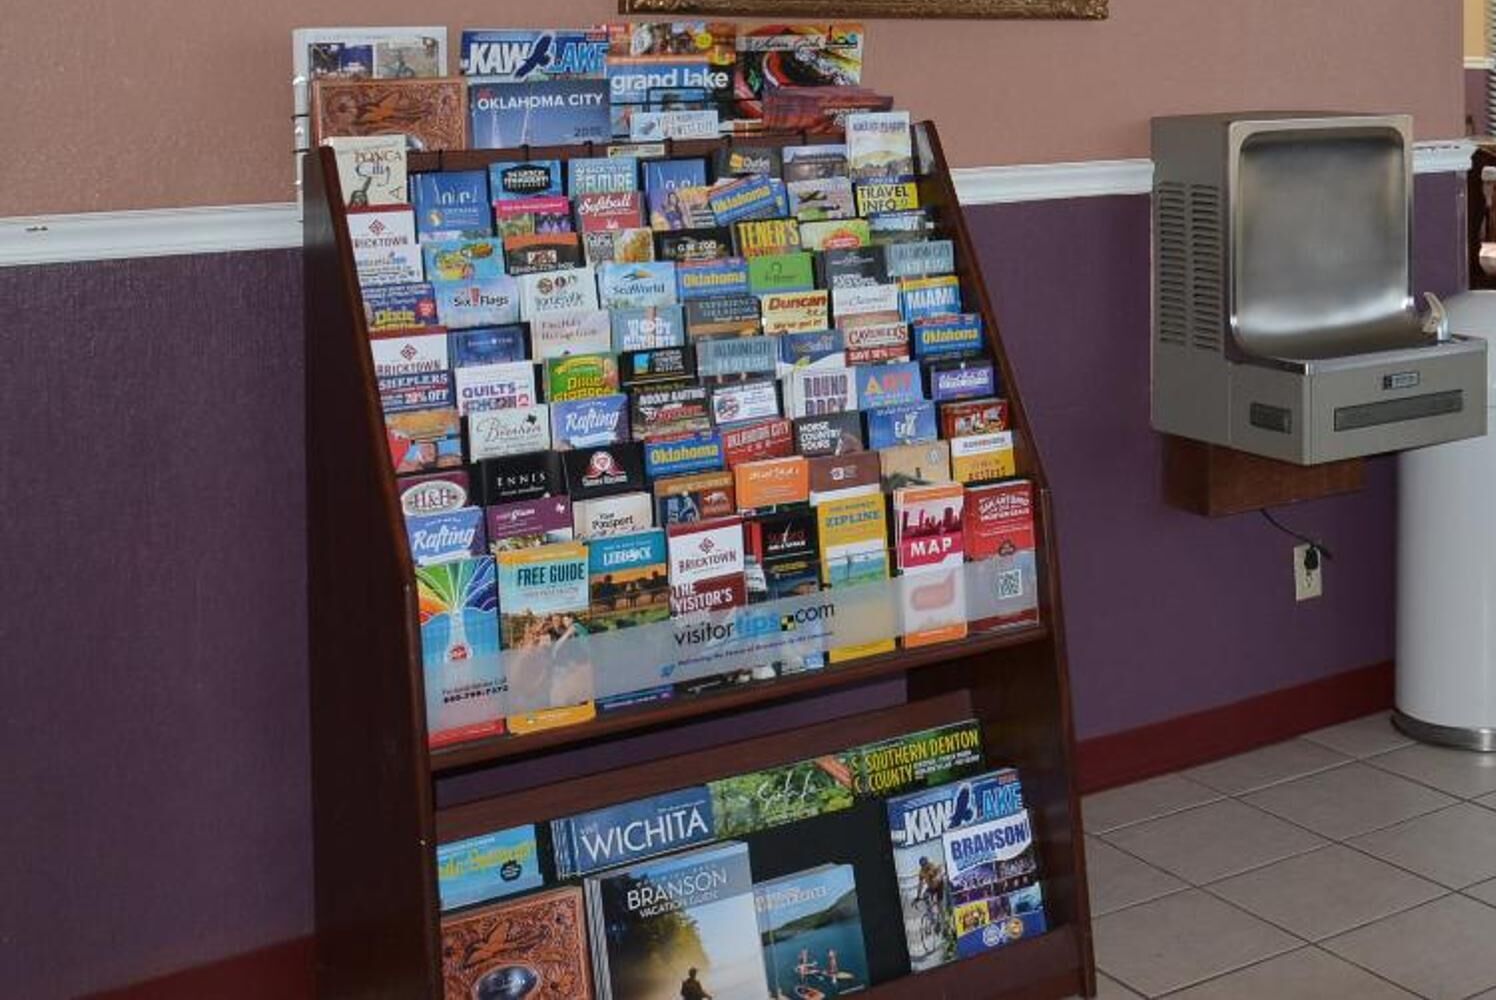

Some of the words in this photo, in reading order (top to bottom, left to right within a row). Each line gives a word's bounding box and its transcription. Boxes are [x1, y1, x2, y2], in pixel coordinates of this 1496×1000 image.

[467, 41, 531, 74] KAW
[547, 42, 609, 72] LAKE
[611, 68, 677, 95] grand
[683, 68, 729, 88] lake
[478, 95, 564, 110] OKLAHOMA
[568, 93, 603, 106] CITY
[586, 173, 633, 190] FUTURE
[859, 186, 909, 198] TRAVEL
[862, 199, 897, 212] INFO
[737, 218, 799, 248] TENER'S
[612, 283, 665, 295] SeaWorld
[683, 272, 747, 287] Oklahoma
[454, 295, 471, 307] Six
[480, 294, 509, 307] Flags
[768, 296, 826, 311] Duncan
[922, 328, 978, 344] Oklahoma
[428, 390, 448, 401] OFF
[462, 383, 517, 398] QUILTS
[804, 375, 848, 397] ROUND
[565, 408, 620, 435] Rafting
[801, 429, 842, 442] COUNTRY
[801, 440, 831, 450] TOURS
[651, 443, 719, 464] Oklahoma
[497, 472, 547, 487] ENNIS
[592, 514, 634, 530] Passport
[413, 525, 476, 555] Rafting
[910, 537, 952, 558] MAP
[678, 550, 737, 574] BRICKTOWN
[517, 566, 548, 588] FREE
[549, 563, 585, 582] GUIDE
[673, 581, 696, 598] THE
[674, 588, 733, 612] VISITOR'S
[865, 741, 927, 773] SOUTHERN
[930, 729, 980, 754] DENTON
[868, 762, 914, 792] COUNTY
[904, 799, 956, 845] KAW
[580, 805, 709, 862] WICHITA
[627, 868, 728, 910] BRANSON
[639, 900, 688, 919] VACATION
